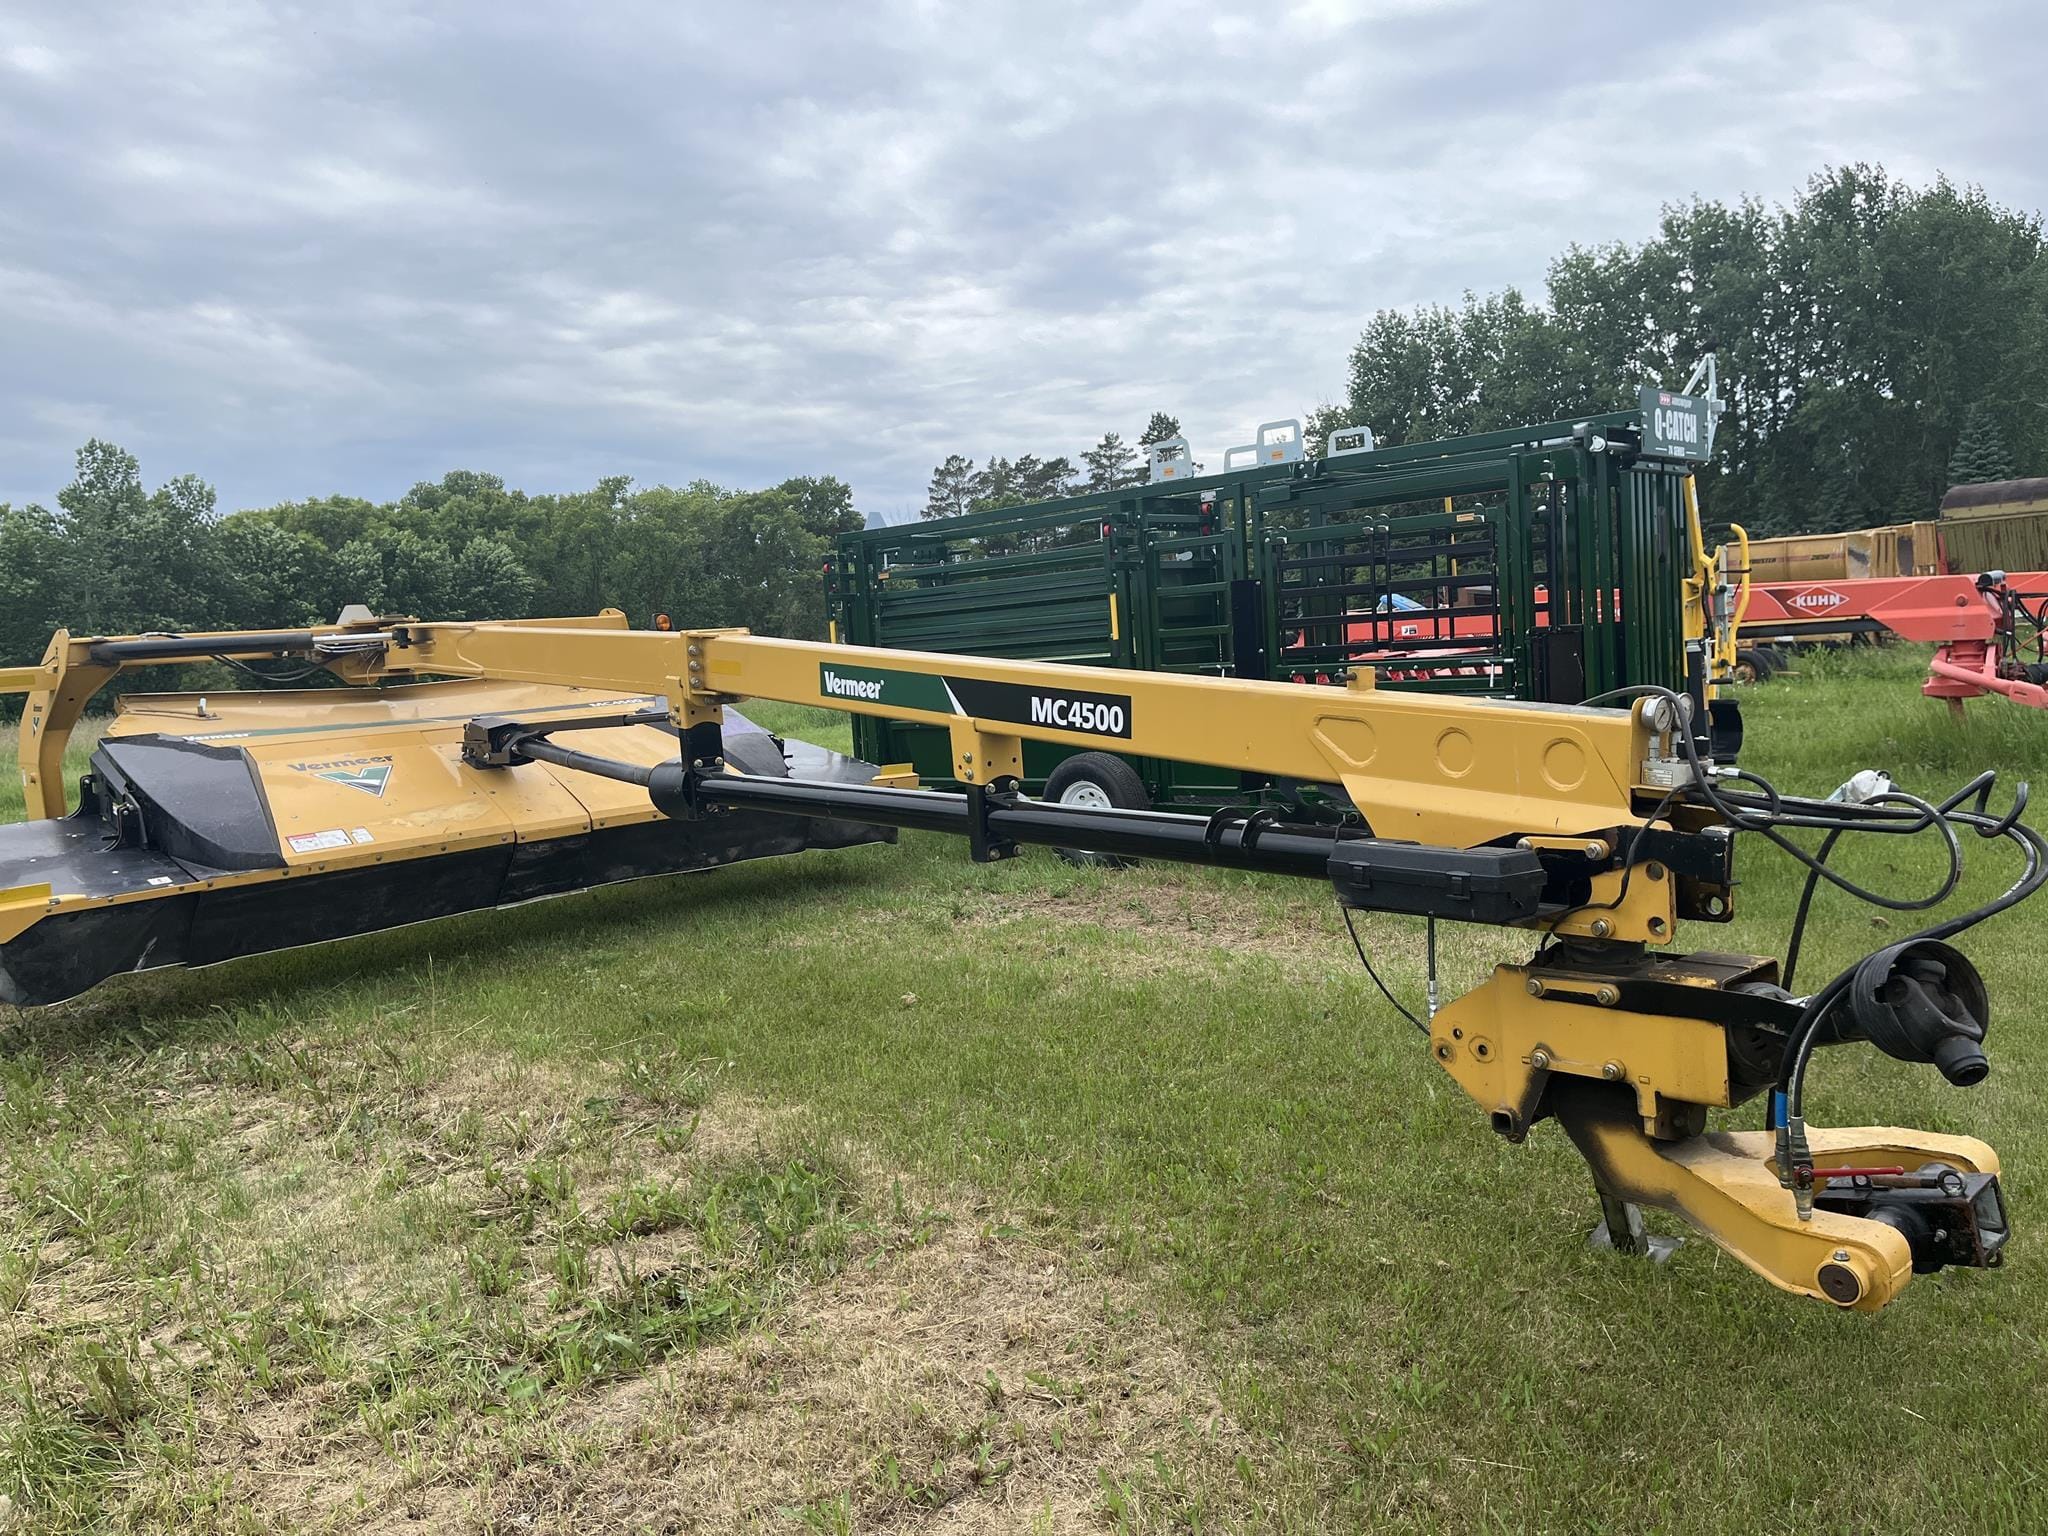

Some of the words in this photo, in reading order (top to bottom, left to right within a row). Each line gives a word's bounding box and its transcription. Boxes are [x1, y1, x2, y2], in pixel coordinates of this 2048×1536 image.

[1655, 408, 1697, 443] Q-CATCH
[1796, 594, 1841, 607] KUHN
[824, 671, 883, 699] Vermeer
[1031, 697, 1124, 733] MC4500
[288, 754, 393, 772] Vermeer
